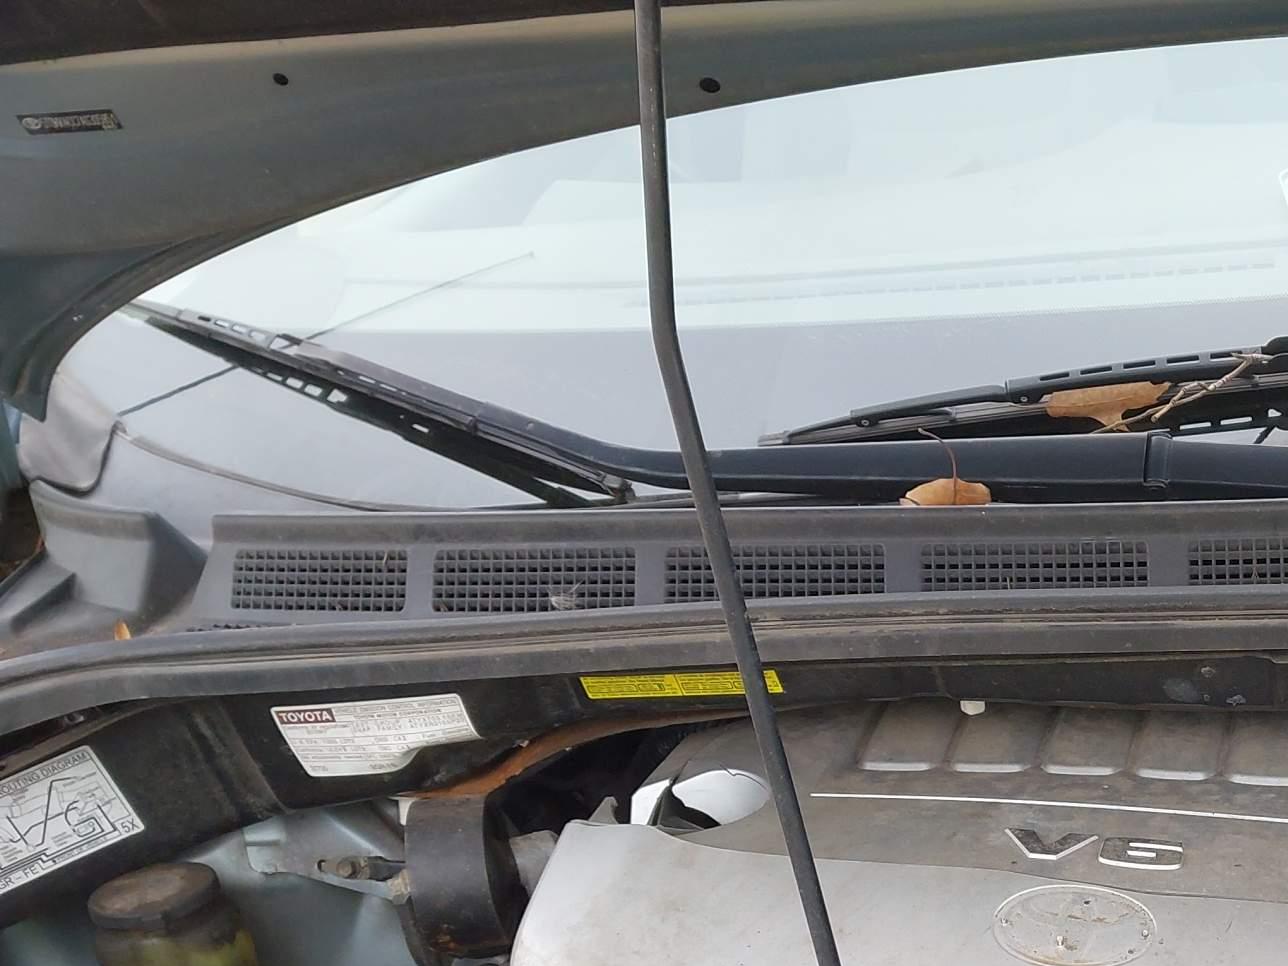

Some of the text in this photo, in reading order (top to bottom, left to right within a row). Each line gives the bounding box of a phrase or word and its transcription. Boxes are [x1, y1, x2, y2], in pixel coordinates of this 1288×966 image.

[278, 710, 332, 723] TOYOTA
[40, 752, 88, 778] DIAGRAM
[120, 817, 140, 834] 5X
[1004, 827, 1185, 871] V6
